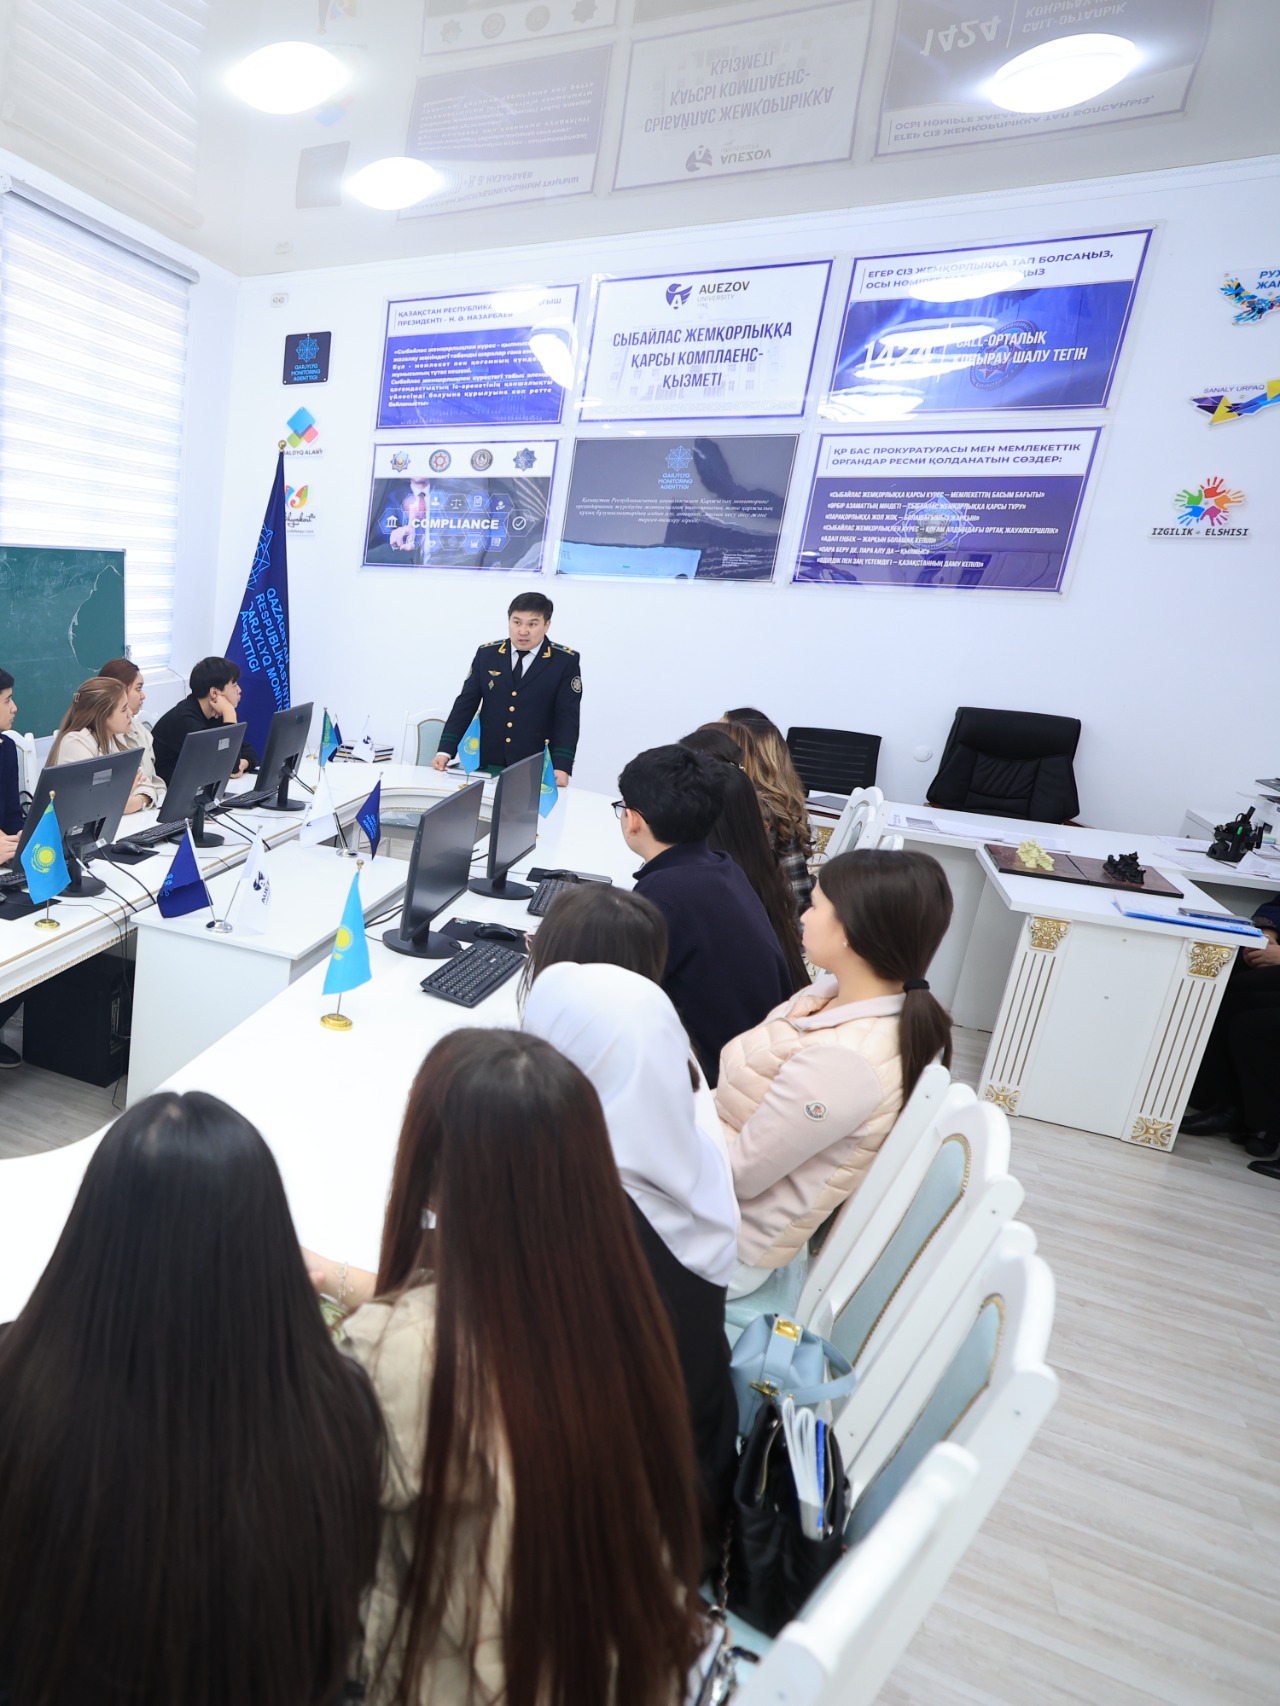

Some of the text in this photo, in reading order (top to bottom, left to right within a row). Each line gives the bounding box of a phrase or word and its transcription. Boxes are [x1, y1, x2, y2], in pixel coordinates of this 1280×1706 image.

[868, 268, 893, 278] ЕГЕР
[896, 267, 913, 276] СІЗ
[1012, 256, 1036, 267] ТАП
[1038, 250, 1114, 265] БОЛСАҢЫЗ,
[699, 281, 750, 295] AUEZOV
[866, 280, 891, 290] ОСЫ
[697, 294, 735, 302] UNIVERSITY
[612, 322, 792, 347] СЫБАЙЛАС ЖЕМҚОРЛЫҚҚА
[631, 347, 764, 369] ҚАРСЫ КОМПЛАЕНС-
[1012, 349, 1050, 363] ШАЛУ
[1053, 347, 1088, 362] ТЕГІН
[663, 372, 722, 389] ҚЫЗМЕТІ
[1203, 384, 1265, 394] SANALY URPAQ
[834, 448, 848, 456] ҚР
[873, 446, 968, 455] ПРОКУРАТУРАСЫ
[970, 445, 995, 453] МЕН
[998, 444, 1081, 453] МЕМЛЕКЕТТІК
[831, 455, 1062, 467] ОРГАНДАР РЕСМИ ҚОЛДАНАТЫН СӨЗДЕР:
[411, 519, 499, 530] COMPLIANCE
[1151, 528, 1249, 537] IZGILIK ELSHISI
